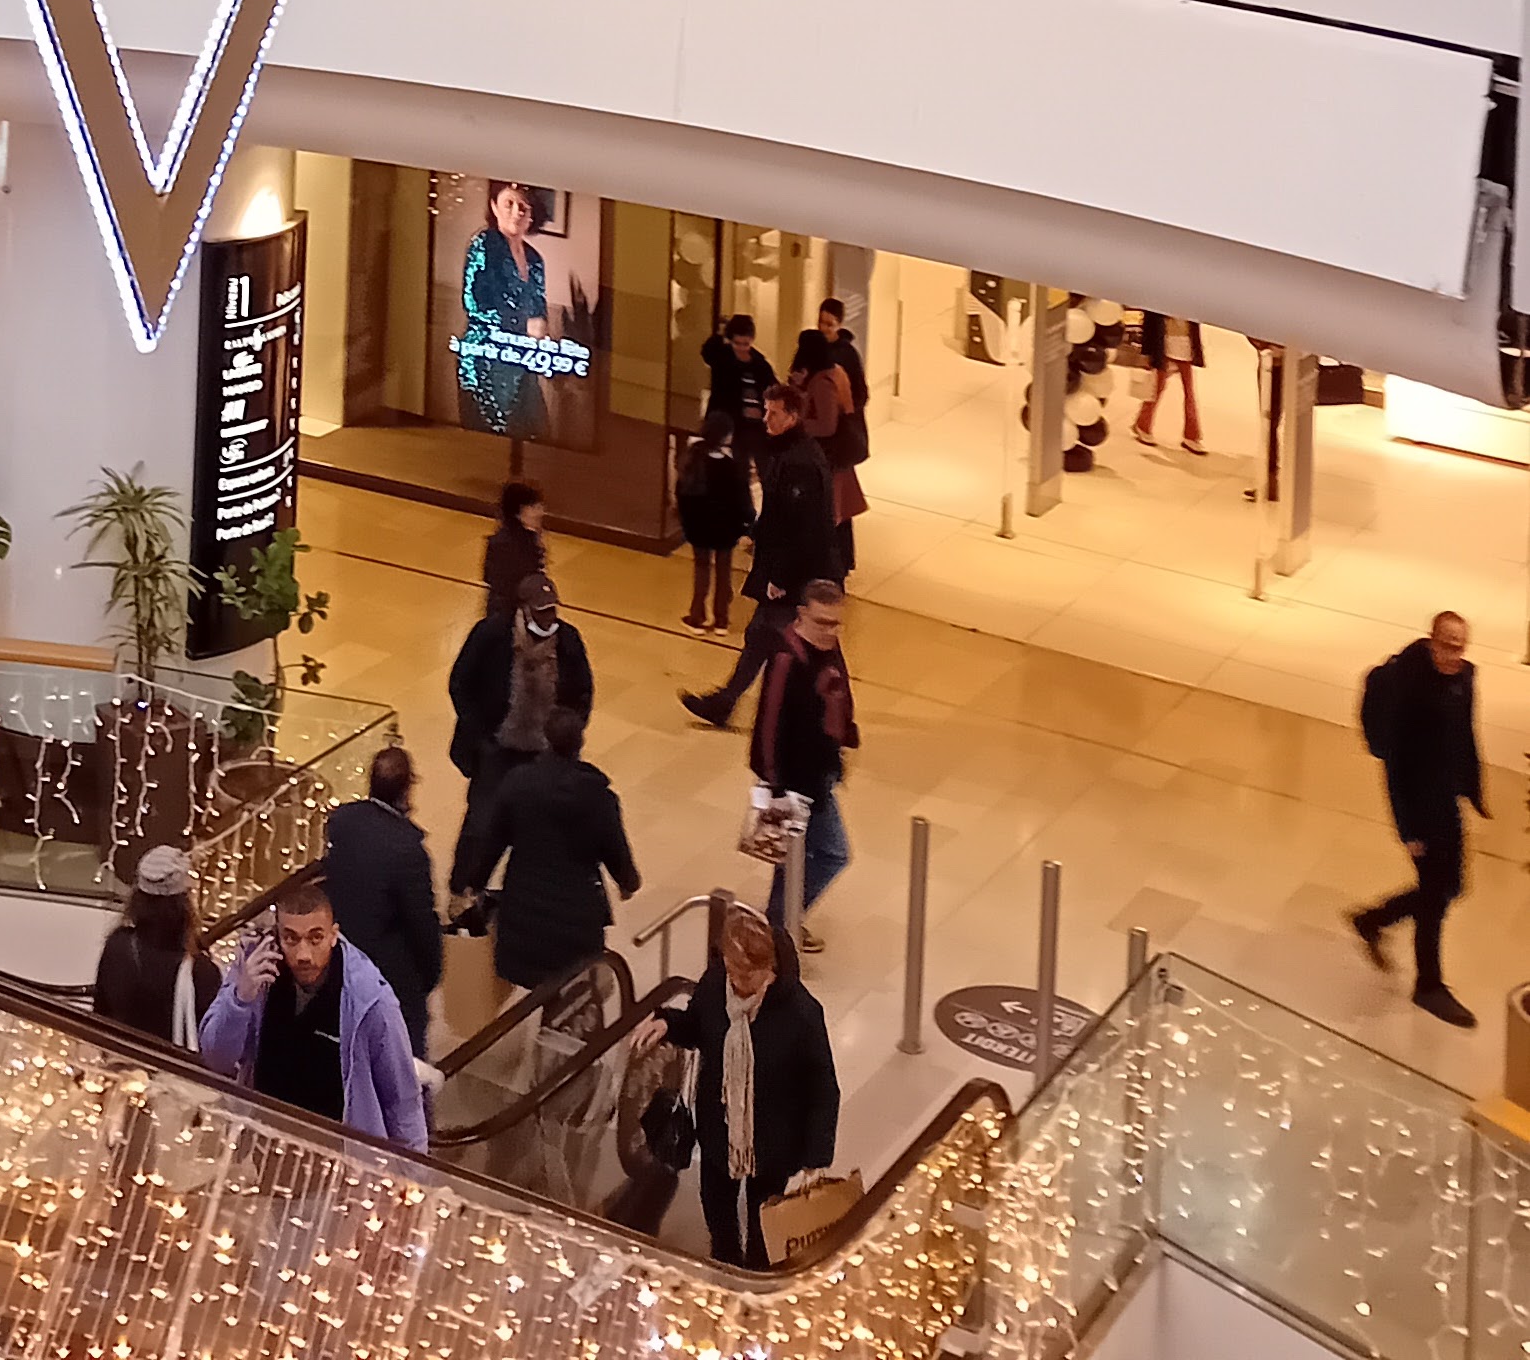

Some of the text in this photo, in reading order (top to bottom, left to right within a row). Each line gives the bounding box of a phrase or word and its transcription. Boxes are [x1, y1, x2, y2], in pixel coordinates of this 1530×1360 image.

[538, 336, 559, 353] de
[500, 346, 521, 363] de
[574, 360, 590, 376] €
[960, 1032, 1038, 1065] TERDIT
